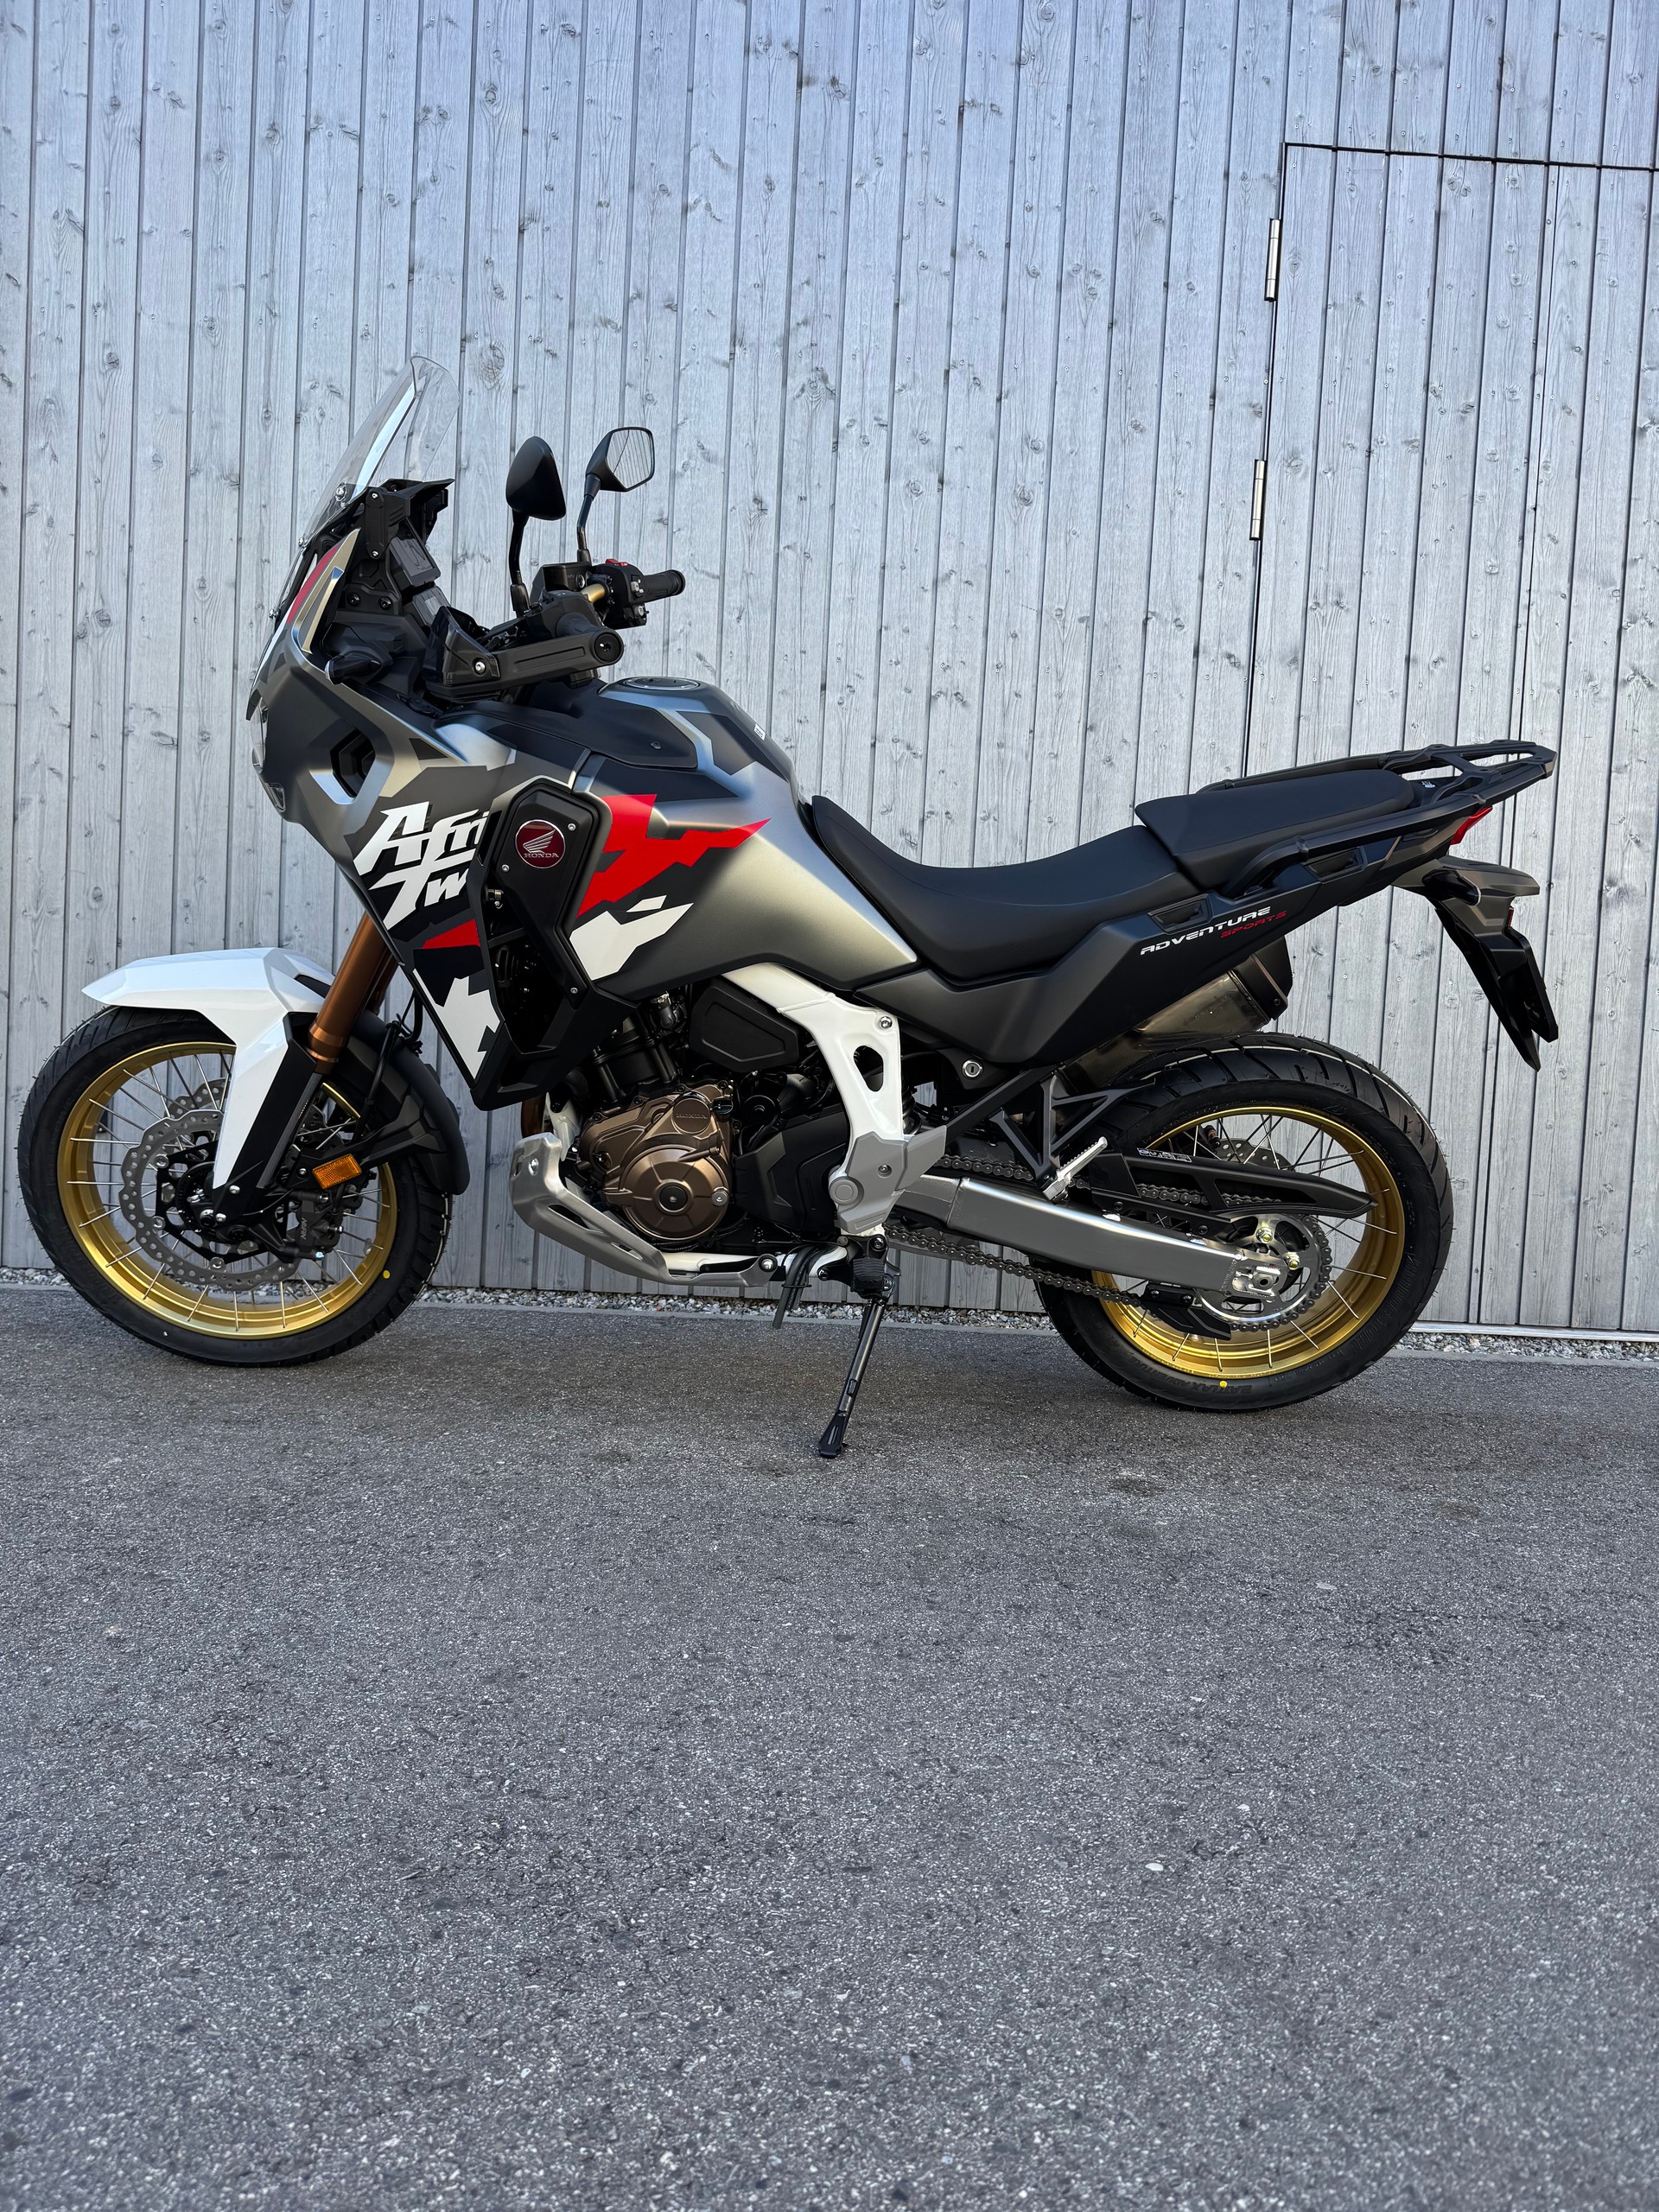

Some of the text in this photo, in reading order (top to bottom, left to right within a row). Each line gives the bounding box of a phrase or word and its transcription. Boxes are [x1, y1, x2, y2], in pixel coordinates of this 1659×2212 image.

[353, 801, 490, 876] Afri
[368, 848, 477, 931] Tw
[1140, 906, 1271, 956] ADVENTURE
[1220, 910, 1287, 938] SPORTS
